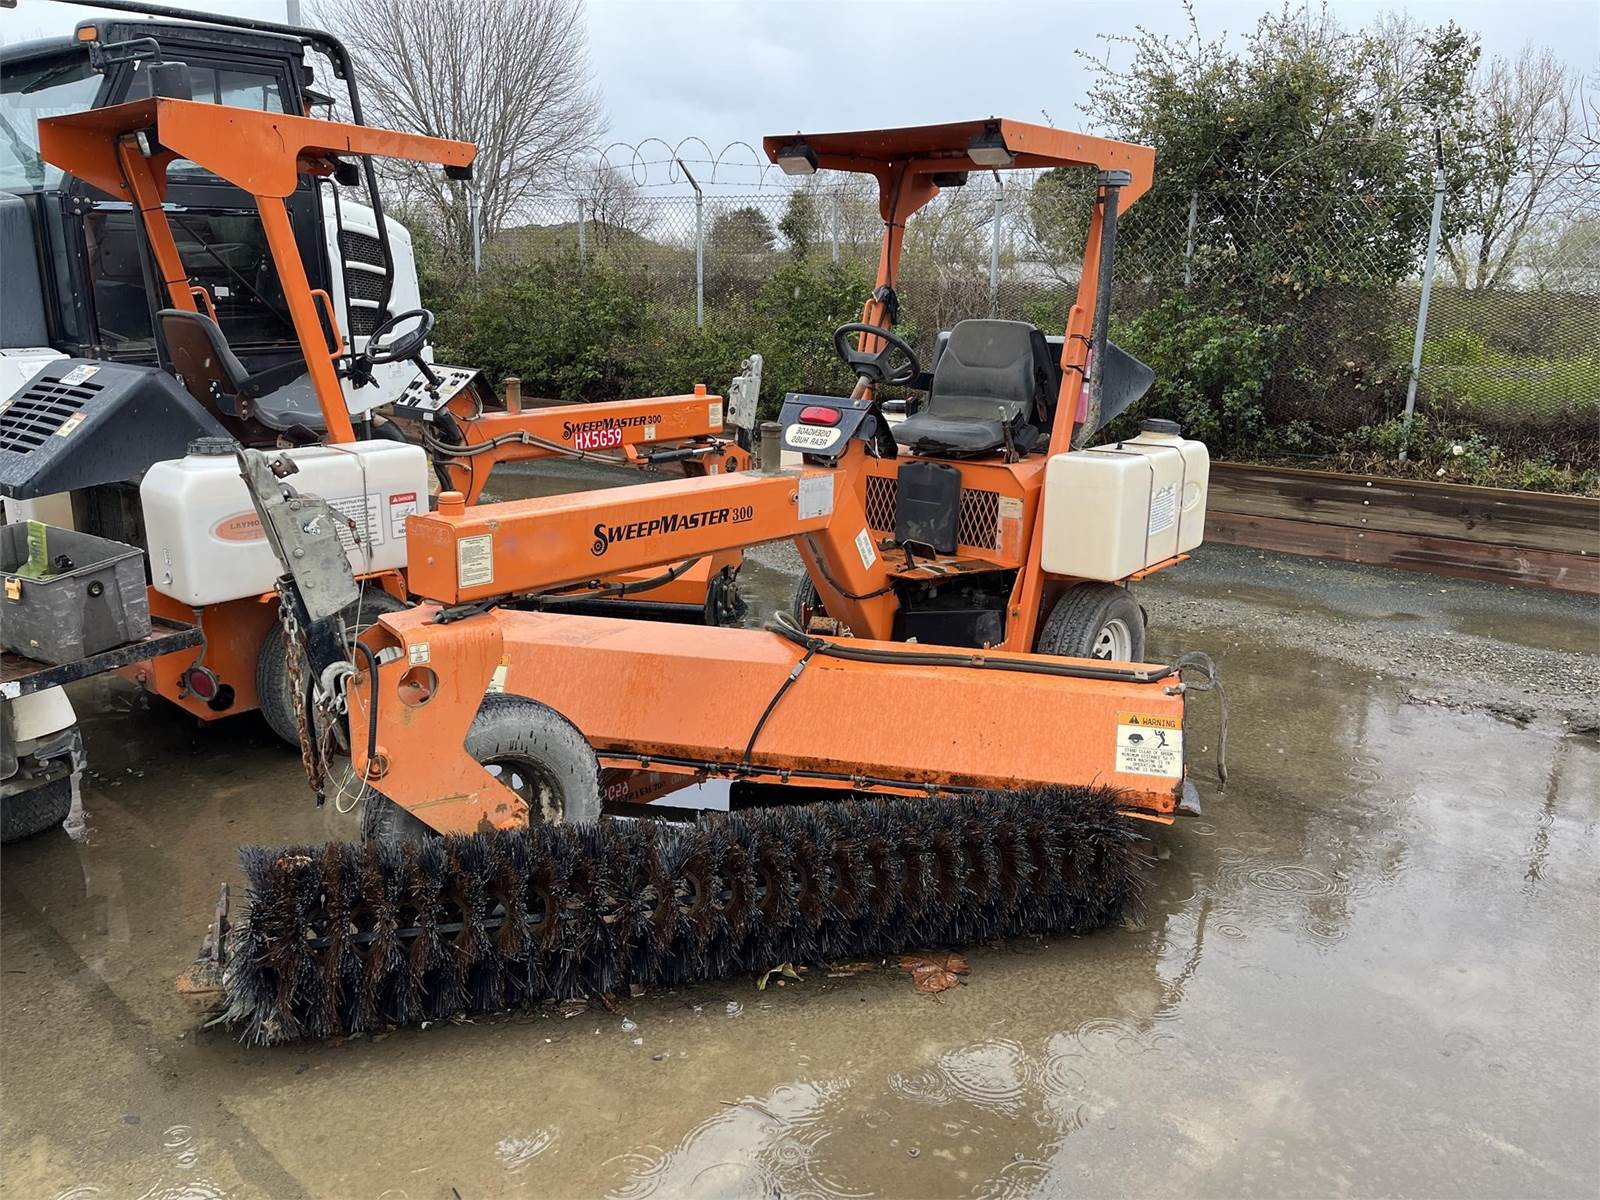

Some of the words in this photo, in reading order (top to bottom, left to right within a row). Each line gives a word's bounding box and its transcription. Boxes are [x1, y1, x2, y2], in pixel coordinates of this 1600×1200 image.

[648, 414, 662, 425] 300
[575, 428, 622, 450] HX5G59
[591, 508, 730, 557] SWEEPMASTER
[732, 505, 753, 522] 300
[1142, 717, 1176, 728] WARNING
